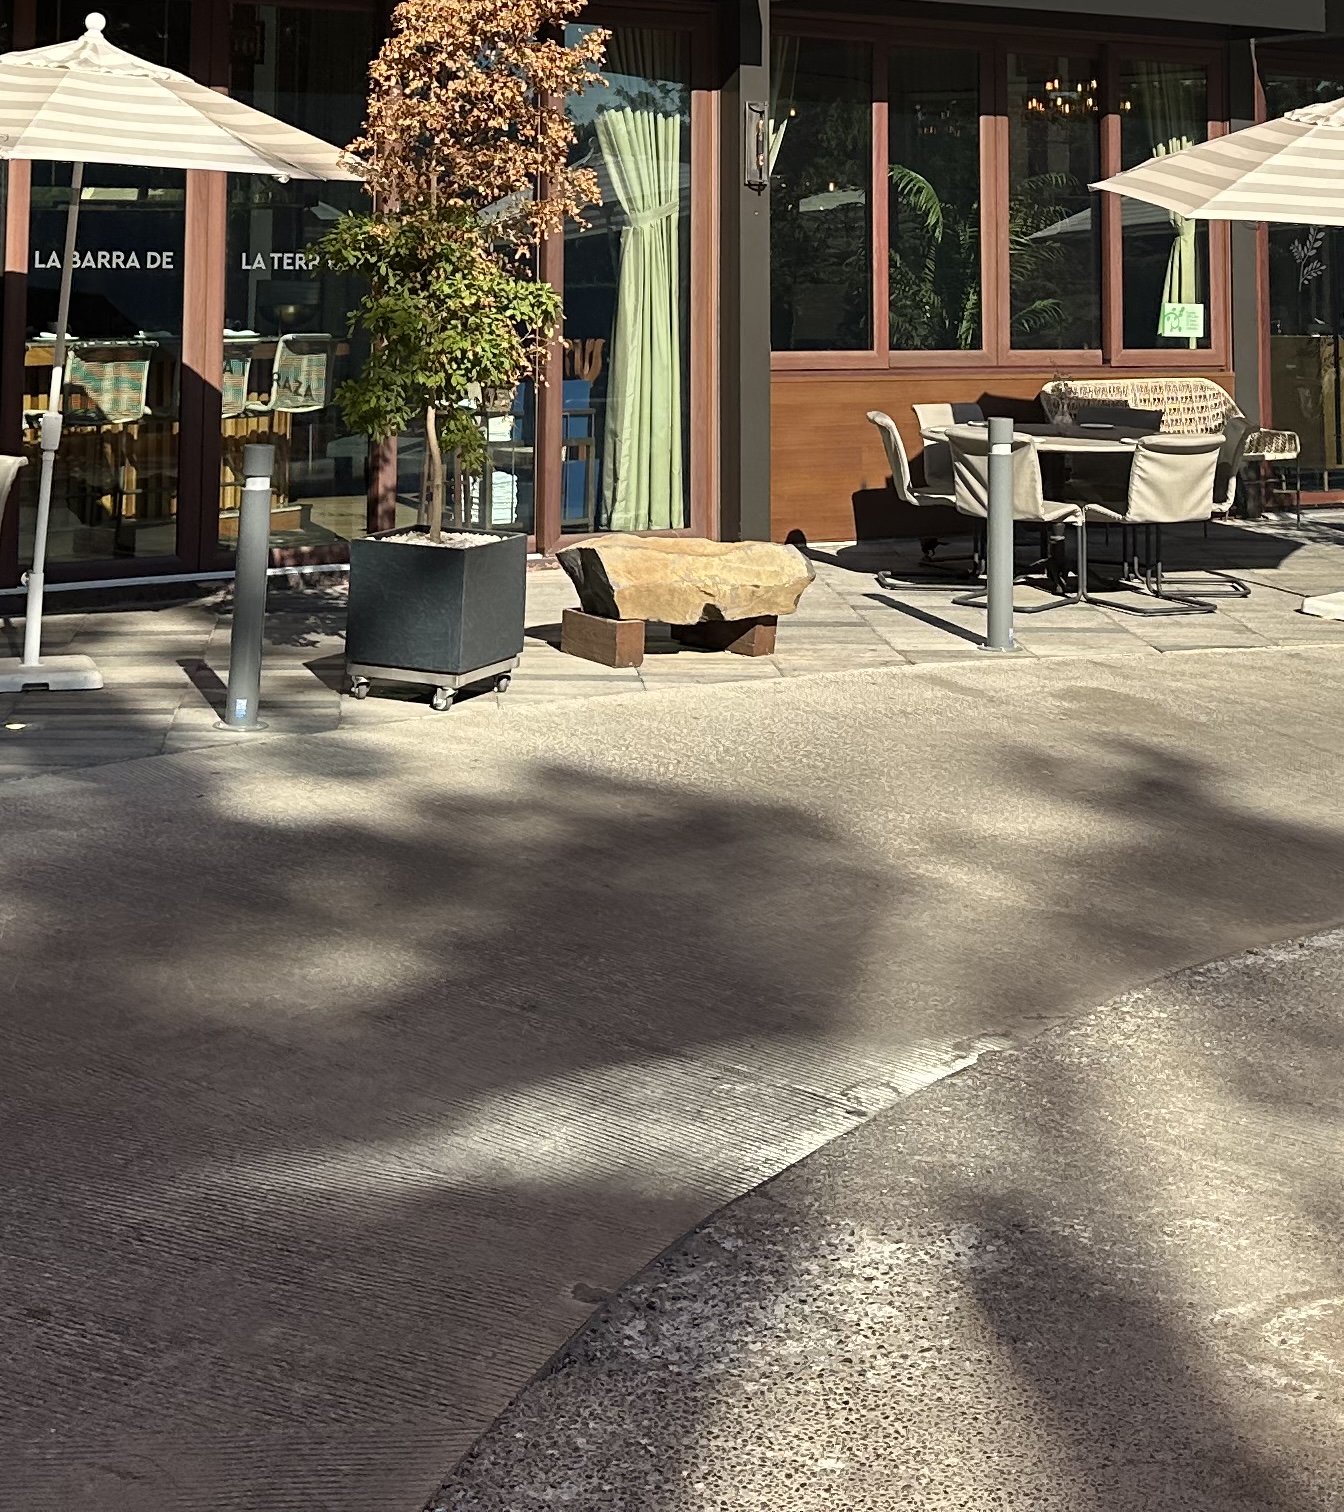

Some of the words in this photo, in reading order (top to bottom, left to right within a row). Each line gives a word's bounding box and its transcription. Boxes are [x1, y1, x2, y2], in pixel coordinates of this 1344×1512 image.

[34, 250, 62, 269] LA
[71, 250, 141, 269] BARRA
[146, 251, 174, 269] DE
[241, 252, 266, 270] LA
